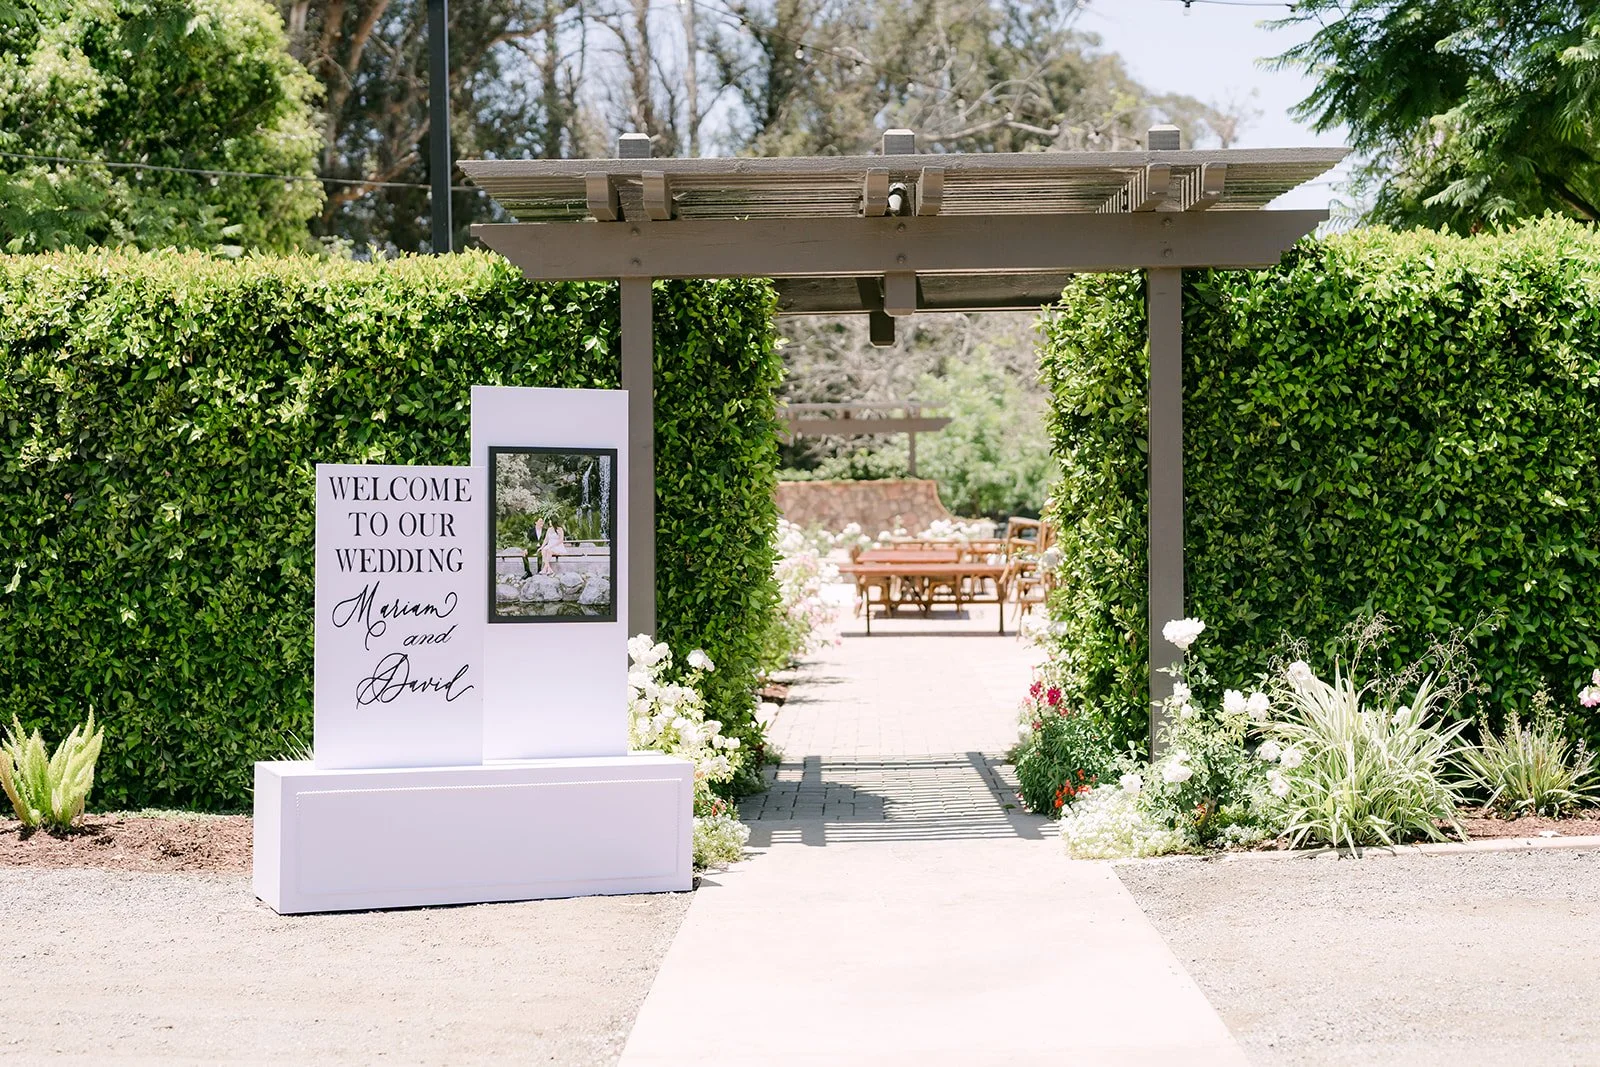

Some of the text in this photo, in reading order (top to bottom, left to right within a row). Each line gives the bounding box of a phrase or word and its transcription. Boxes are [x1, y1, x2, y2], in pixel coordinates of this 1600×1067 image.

[329, 476, 472, 502] WELCOME
[348, 512, 456, 537] TO OUR
[336, 548, 464, 573] WEDDING
[332, 581, 458, 651] Mariam
[403, 624, 458, 646] and
[356, 653, 474, 709] David
